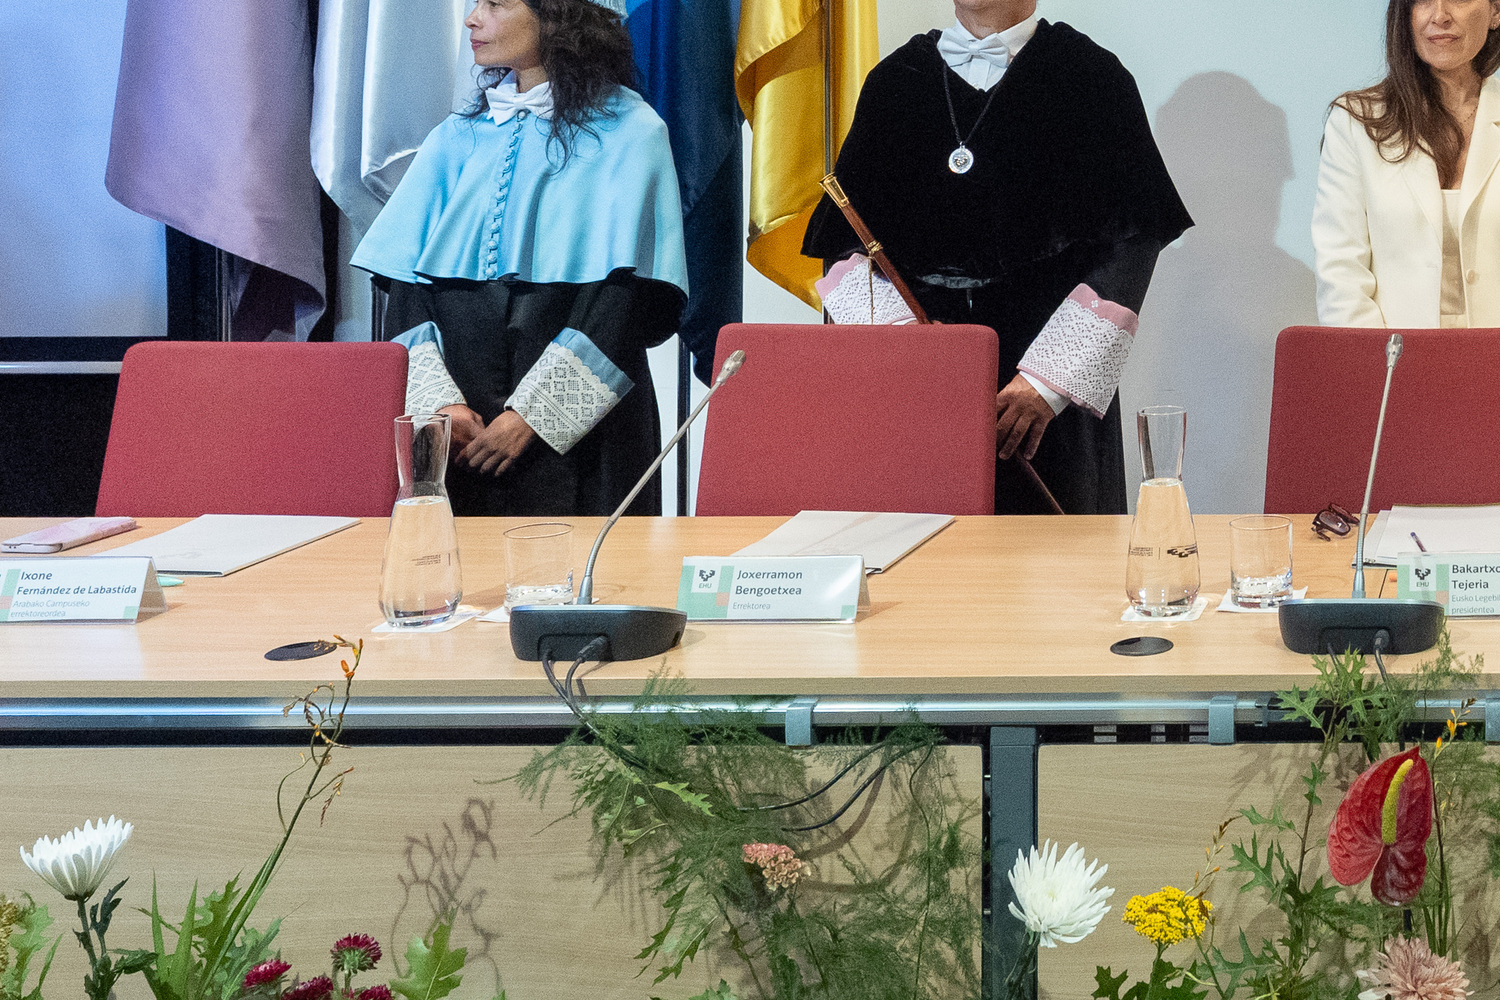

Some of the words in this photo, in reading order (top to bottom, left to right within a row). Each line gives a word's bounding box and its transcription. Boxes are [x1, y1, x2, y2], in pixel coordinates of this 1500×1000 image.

[20, 571, 53, 581] Ixone
[737, 570, 803, 581] Joxerramon
[16, 585, 72, 595] Fernández
[73, 585, 86, 594] de
[87, 584, 137, 595] Labastida
[1451, 580, 1489, 591] Tejeria
[735, 586, 802, 597] Bengoetxea
[1451, 594, 1474, 602] Eusko
[12, 600, 45, 608] Arabako
[46, 599, 91, 609] Campuseko
[732, 601, 771, 610] Errektorea
[10, 609, 67, 618] errektoreordea
[1451, 606, 1495, 615] presidentea
